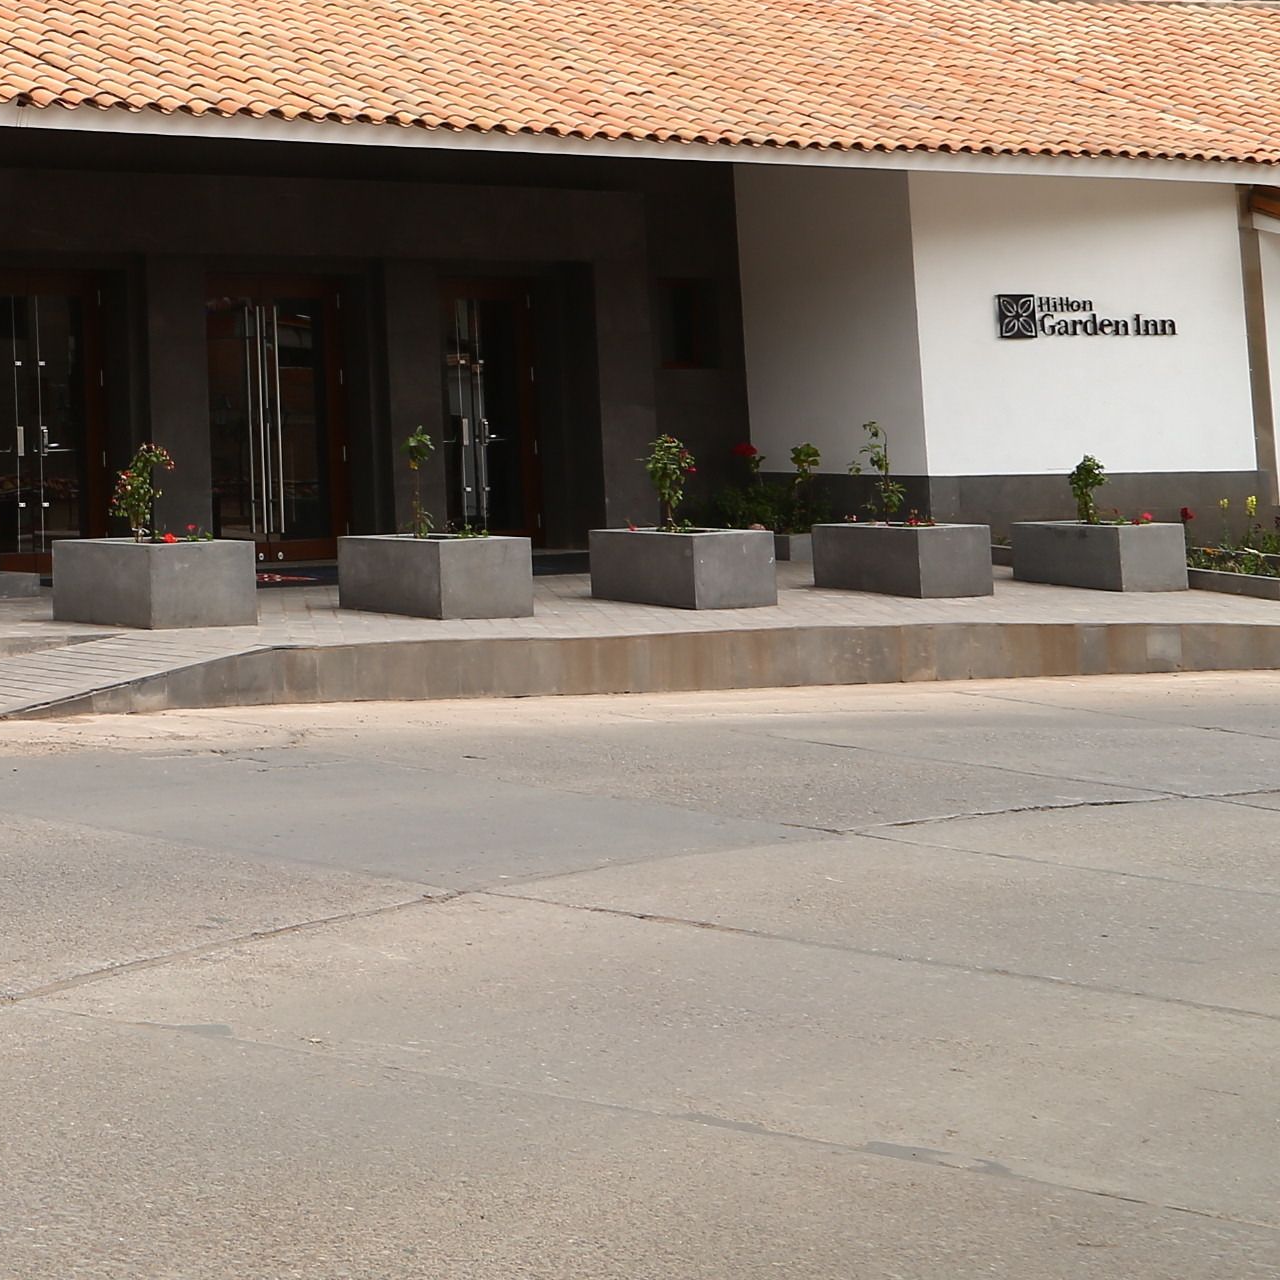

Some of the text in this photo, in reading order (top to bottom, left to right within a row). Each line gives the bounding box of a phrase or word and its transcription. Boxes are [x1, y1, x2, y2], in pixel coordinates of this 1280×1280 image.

[1038, 296, 1093, 312] Hilton
[1040, 313, 1177, 336] Garden Inn
